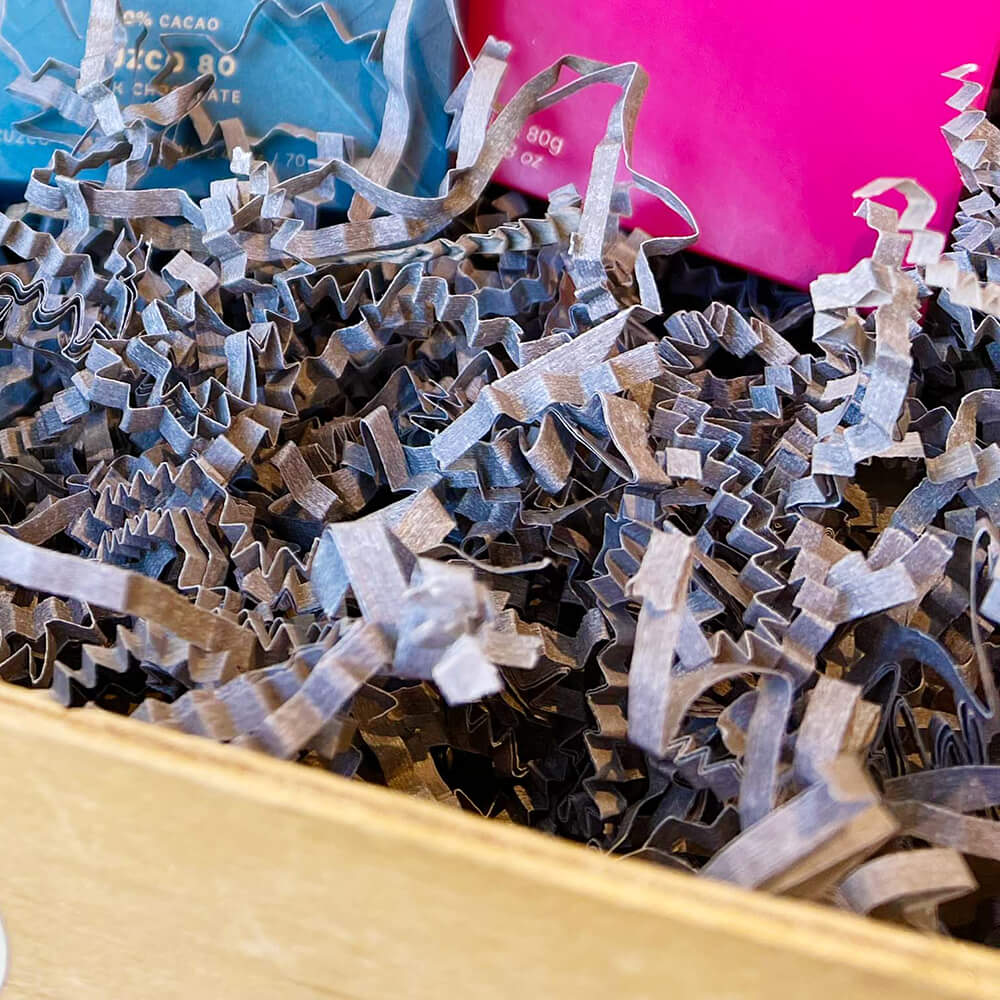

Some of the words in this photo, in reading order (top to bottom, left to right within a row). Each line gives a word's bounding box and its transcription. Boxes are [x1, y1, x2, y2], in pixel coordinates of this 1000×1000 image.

[121, 9, 154, 28] 0%
[159, 14, 221, 32] CACAO
[114, 47, 186, 74] UZCO
[197, 53, 237, 77] 80
[526, 124, 564, 157] 80g
[520, 150, 545, 170] oz
